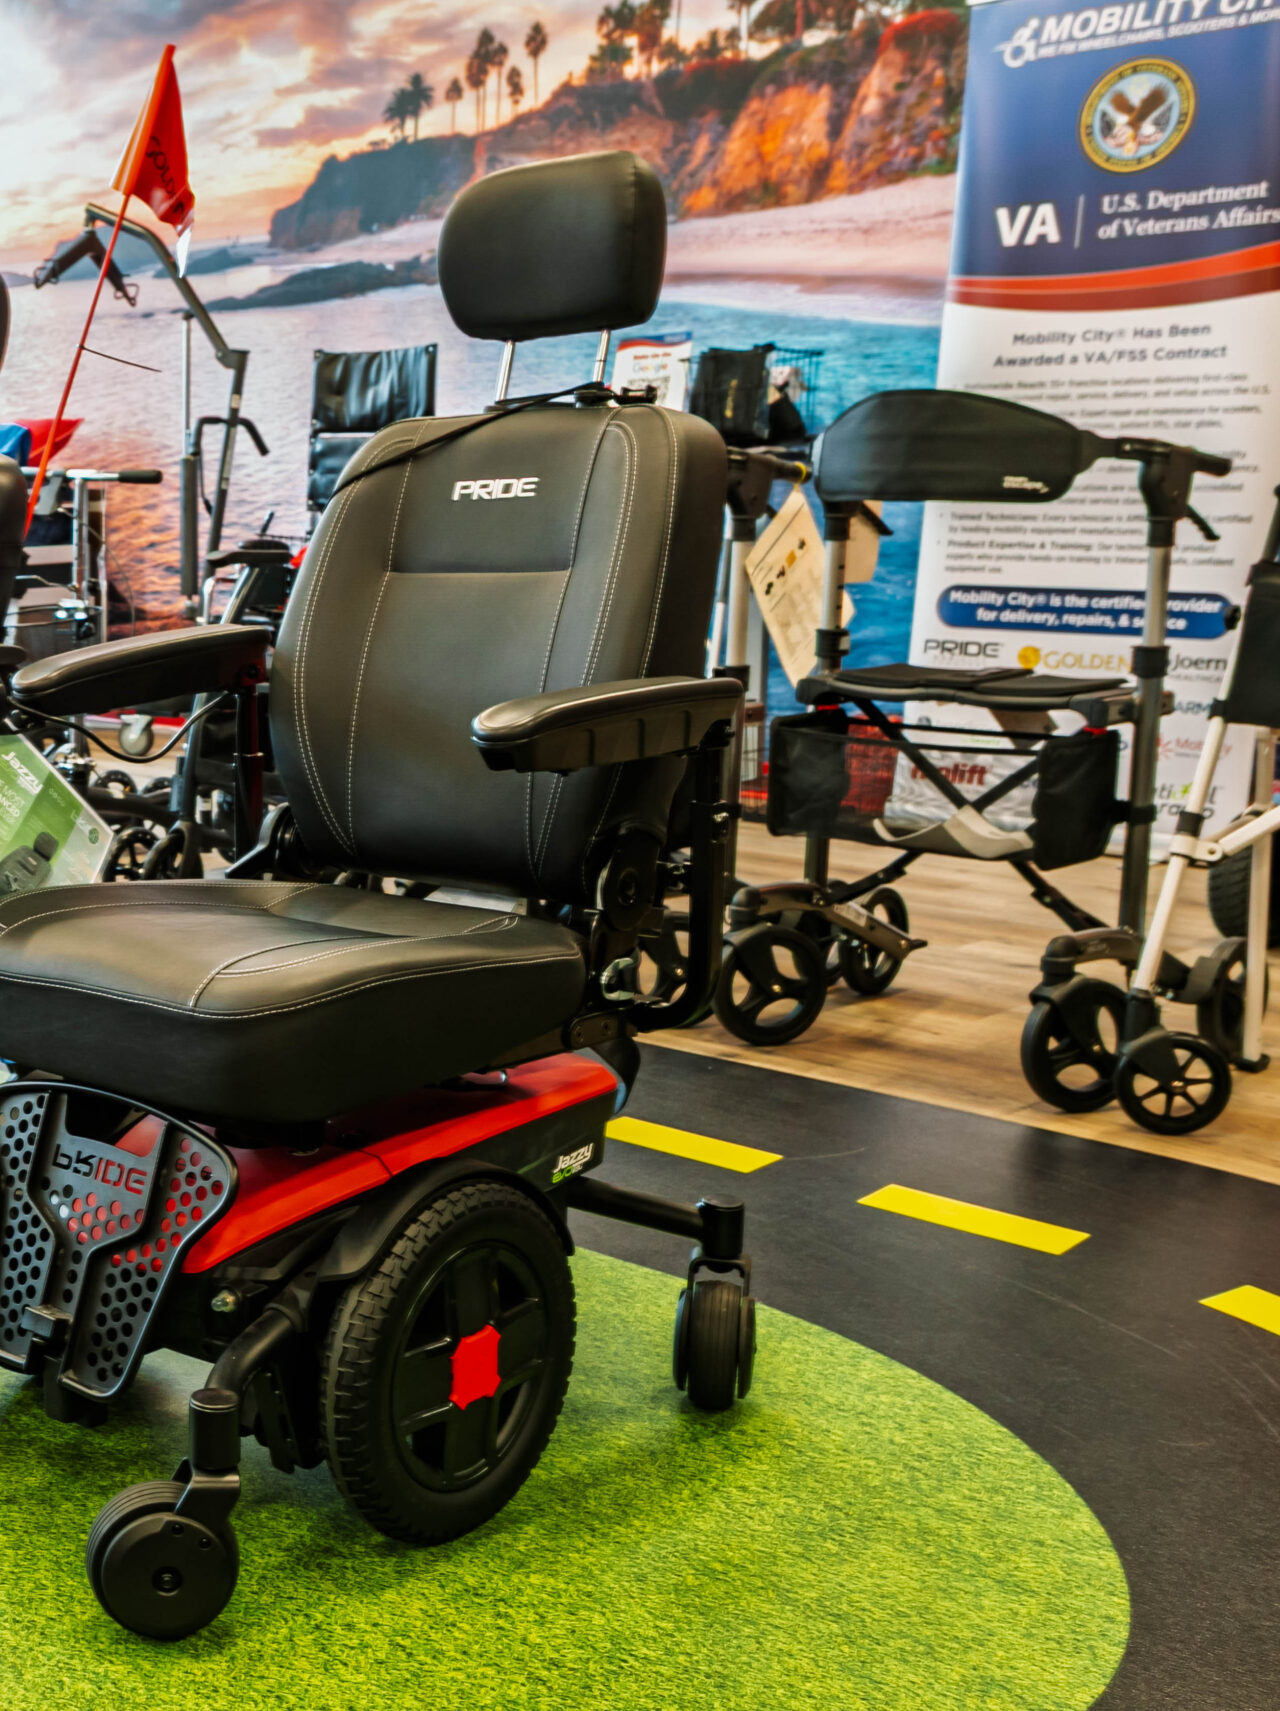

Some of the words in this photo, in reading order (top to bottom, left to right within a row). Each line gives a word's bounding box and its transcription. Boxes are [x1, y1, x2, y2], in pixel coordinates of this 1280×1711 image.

[1166, 14, 1236, 38] SCOOTERS
[995, 203, 1062, 248] VA
[1101, 193, 1142, 214] U.S.
[1147, 180, 1269, 211] Department
[1097, 219, 1118, 240] of
[1123, 211, 1210, 237] Veterans
[1211, 205, 1280, 229] Affairs
[1012, 331, 1076, 346] Mobility
[1132, 325, 1163, 339] Has
[1168, 323, 1212, 337] Been
[993, 354, 1066, 368] Awarded
[1084, 347, 1148, 364] VA/FSS
[1152, 345, 1227, 361] Contract
[452, 477, 541, 501] PRIDE
[949, 590, 1005, 607] Mobility
[1049, 592, 1062, 608] is
[1064, 593, 1089, 608] the
[1090, 594, 1146, 611] certifie
[1166, 598, 1223, 613] rovider
[976, 607, 998, 622] for
[999, 608, 1059, 626] delivery,
[1061, 611, 1117, 629] repairs,
[1117, 613, 1131, 628] &
[924, 639, 1002, 658] PRIDE
[1, 751, 43, 795] Jazzy
[552, 1142, 595, 1174] Jazzy
